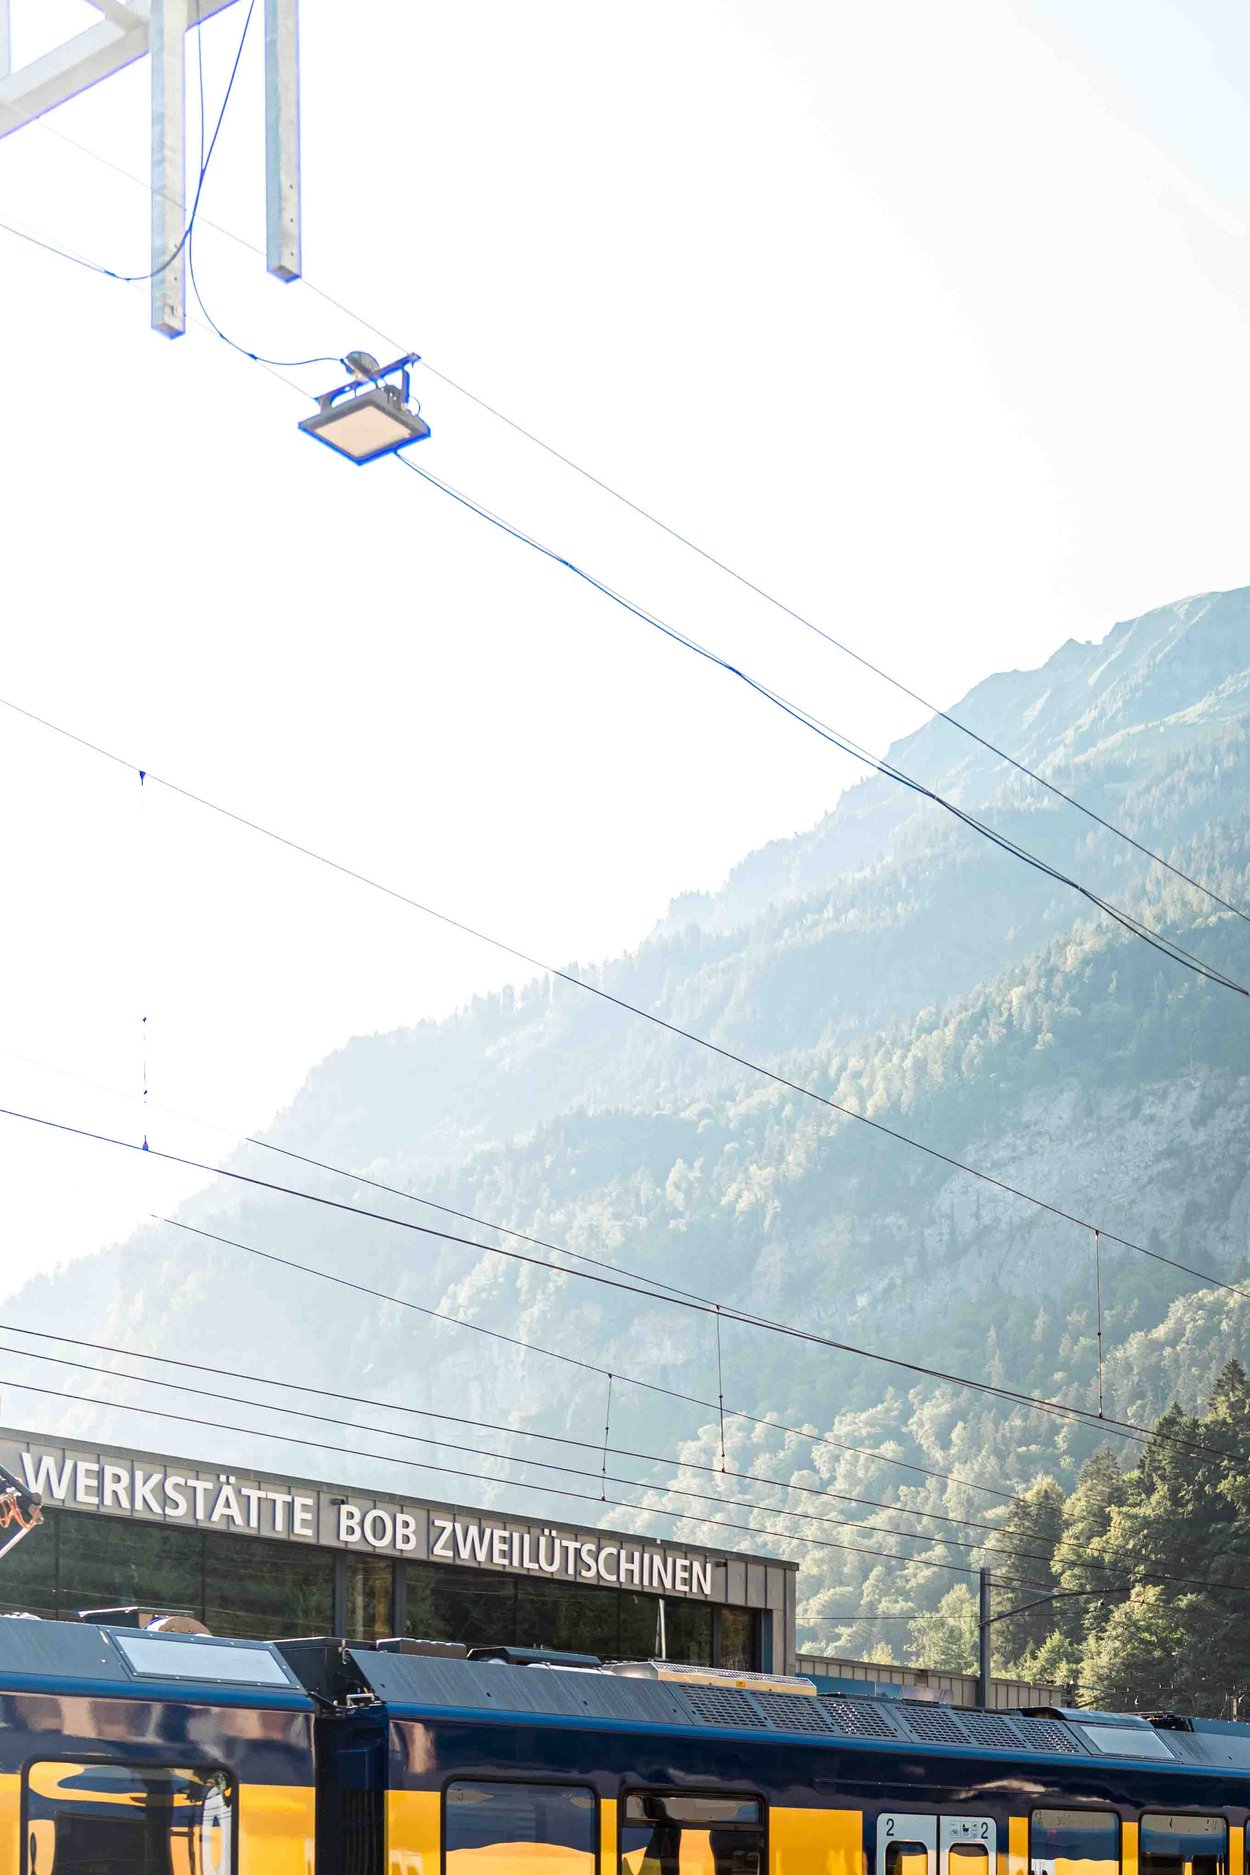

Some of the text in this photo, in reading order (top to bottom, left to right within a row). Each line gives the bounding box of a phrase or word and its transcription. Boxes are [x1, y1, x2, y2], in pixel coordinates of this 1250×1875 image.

[21, 1452, 712, 1595] WERKSTÄTTE BOB ZWEILÜTSCHINEN
[886, 1818, 895, 1836] 2
[980, 1822, 989, 1839] 2
